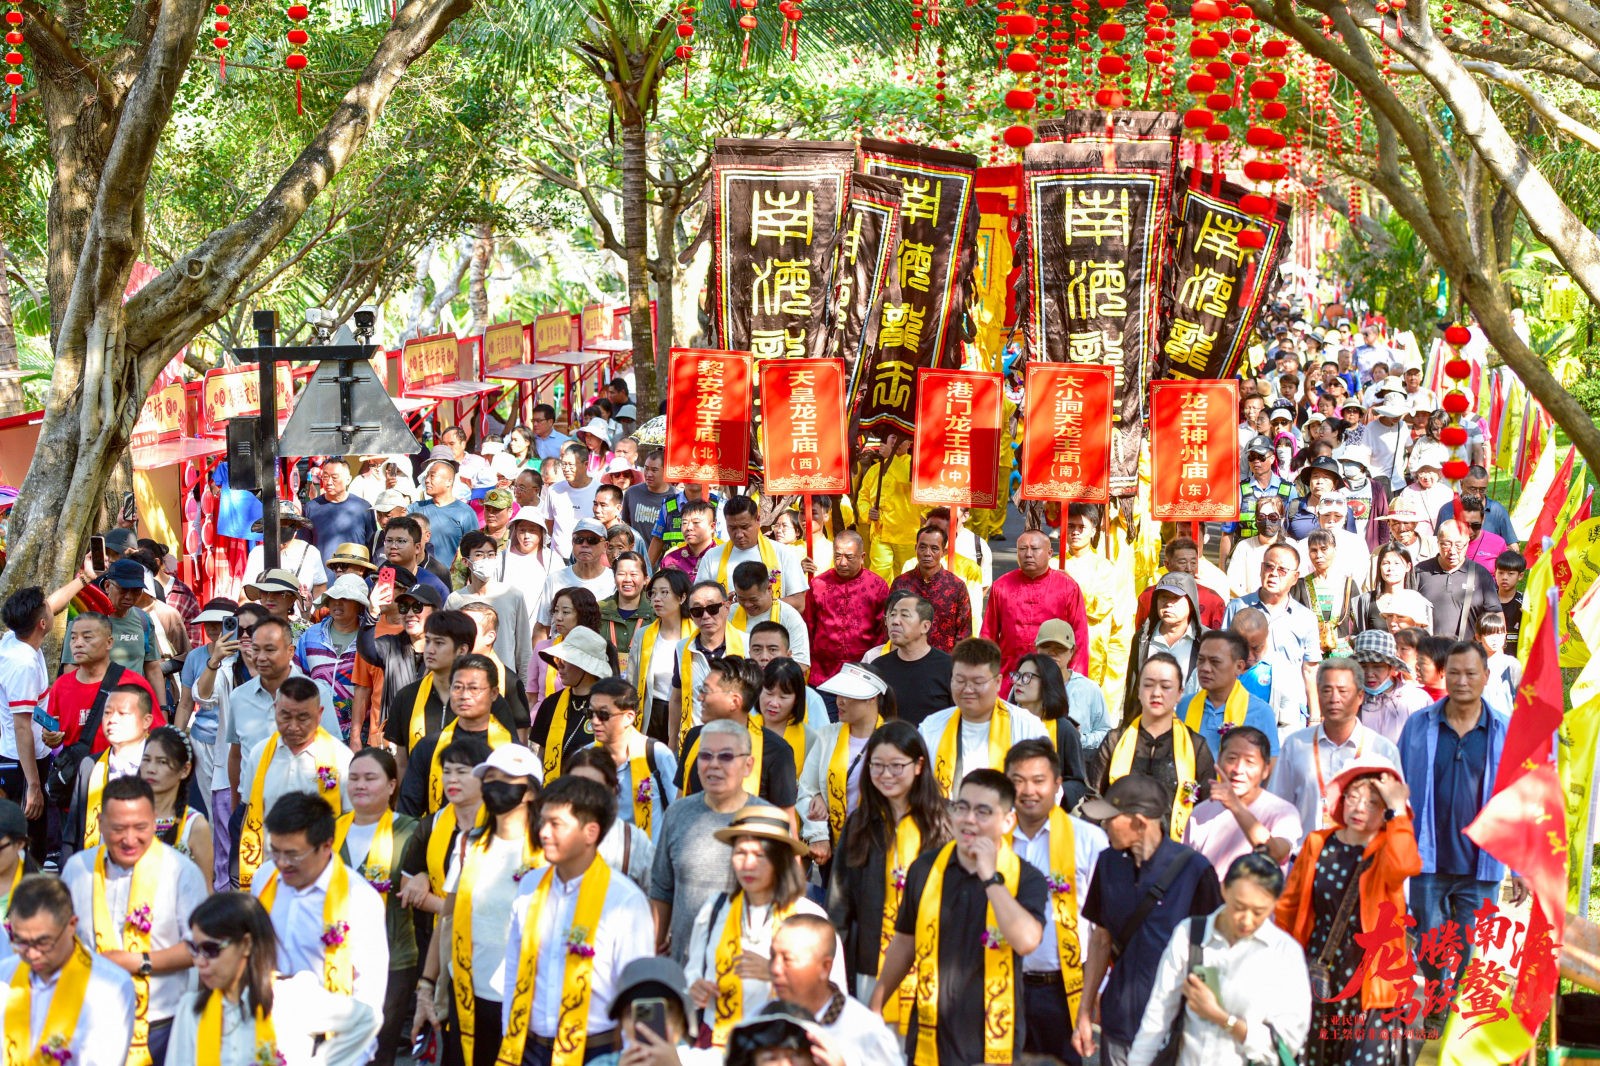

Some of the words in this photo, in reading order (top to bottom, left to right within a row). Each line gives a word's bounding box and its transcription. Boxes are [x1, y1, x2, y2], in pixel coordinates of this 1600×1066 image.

[694, 360, 724, 443] 黎安龙王庙
[788, 370, 818, 453] 天皇龙王庙
[943, 381, 973, 466] 港门龙王庙
[1052, 375, 1085, 464] 大小洞天龙王庙
[691, 447, 722, 460] （北）
[1180, 391, 1209, 480] 龙王神州庙
[790, 457, 821, 470] （西）
[939, 469, 971, 483] （中）
[1050, 465, 1081, 479] （南）
[1179, 482, 1211, 497] （东）
